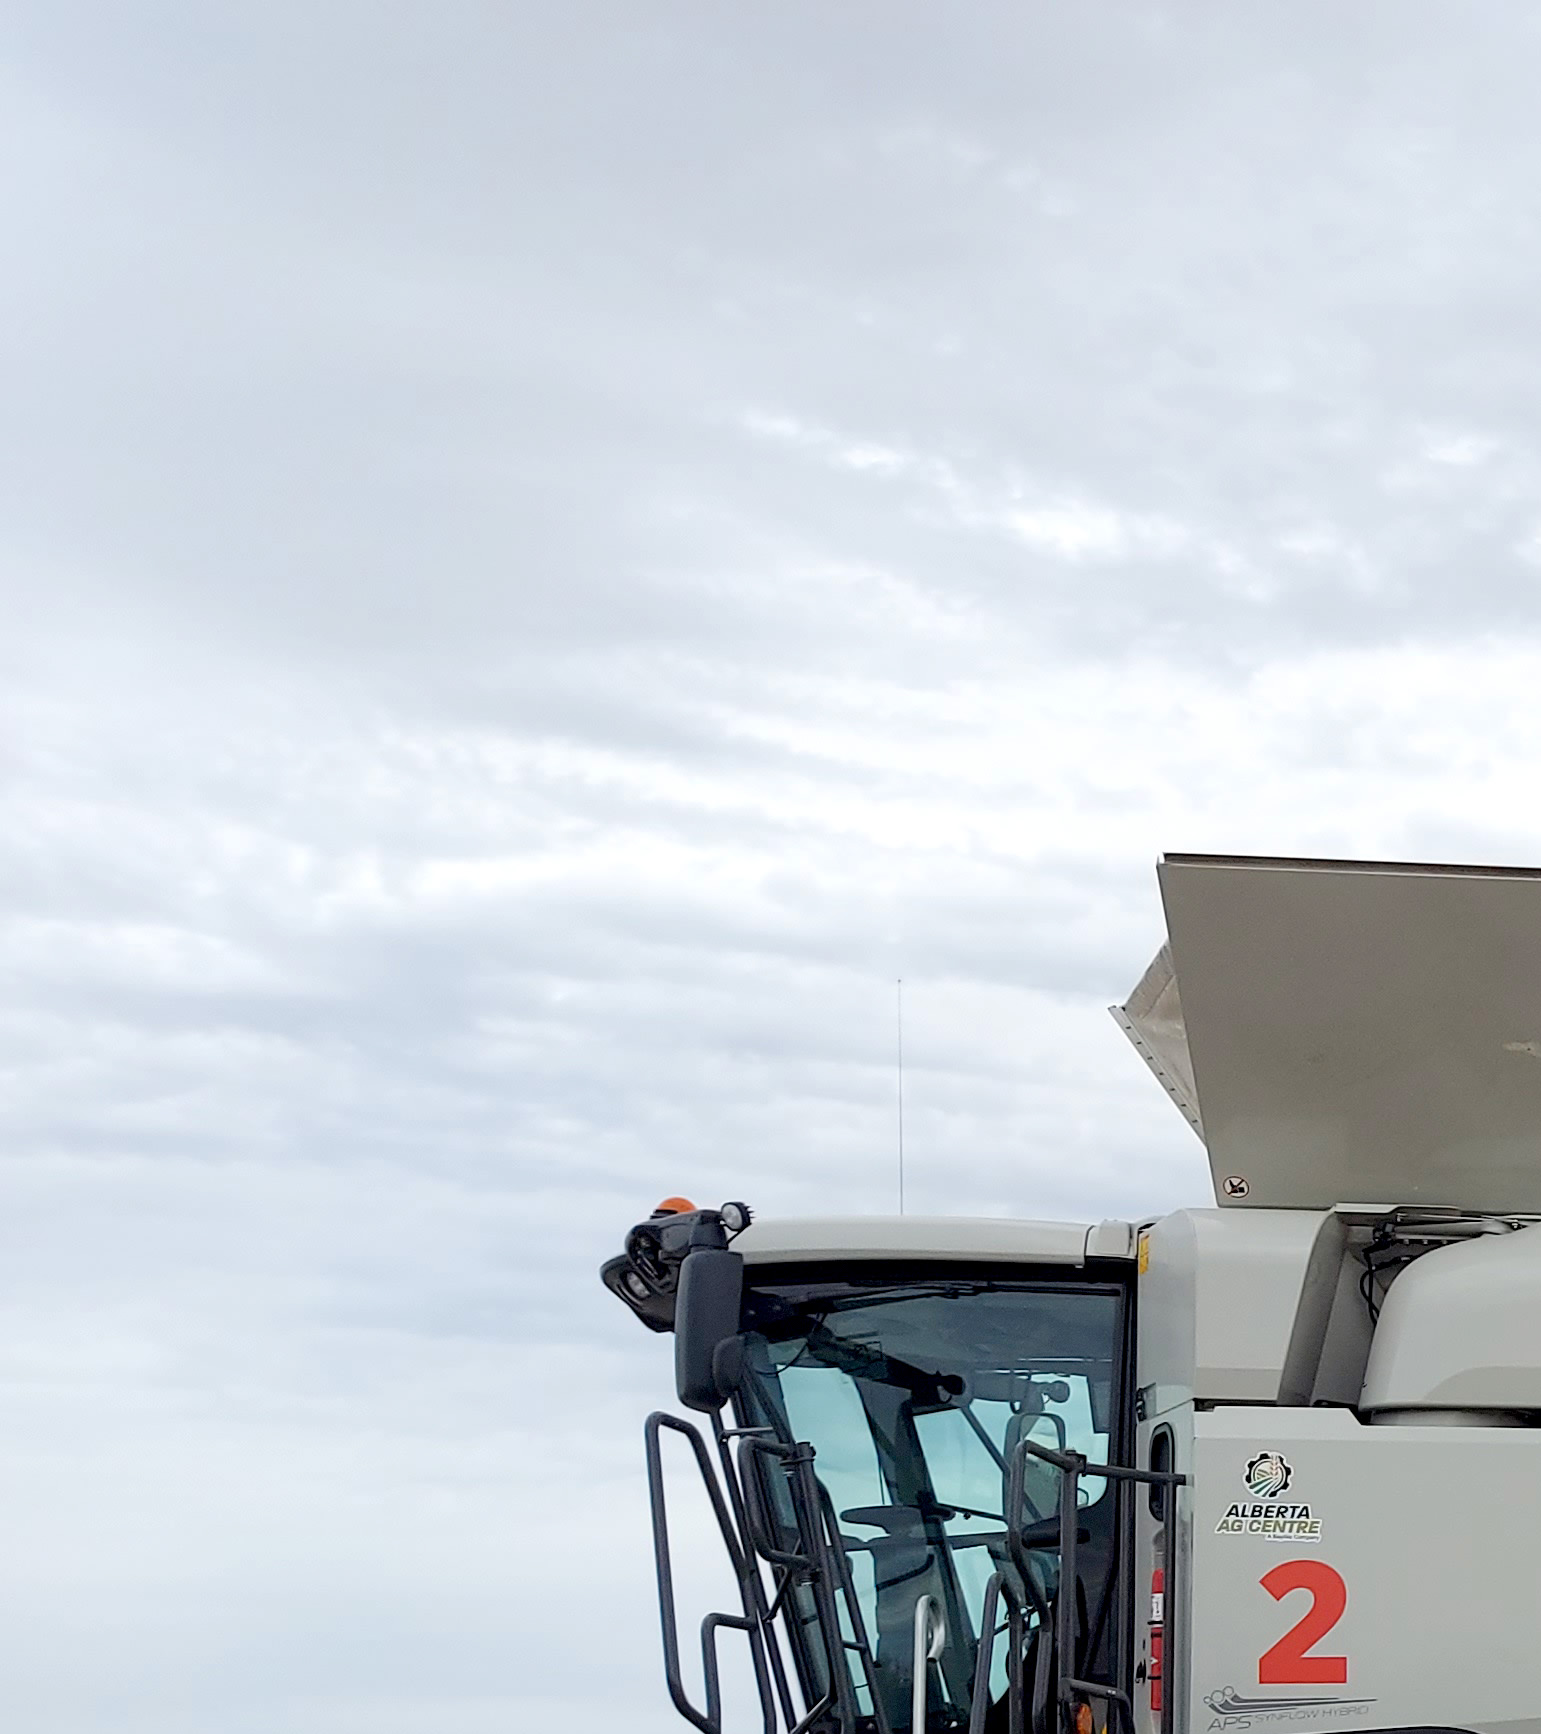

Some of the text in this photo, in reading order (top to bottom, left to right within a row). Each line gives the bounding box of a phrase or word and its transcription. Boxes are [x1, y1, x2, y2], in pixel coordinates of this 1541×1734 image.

[1225, 1503, 1311, 1519] ALBERTA
[1216, 1519, 1321, 1534] AG CENTRE
[1259, 1560, 1347, 1684] 2
[1207, 1714, 1252, 1733] APS
